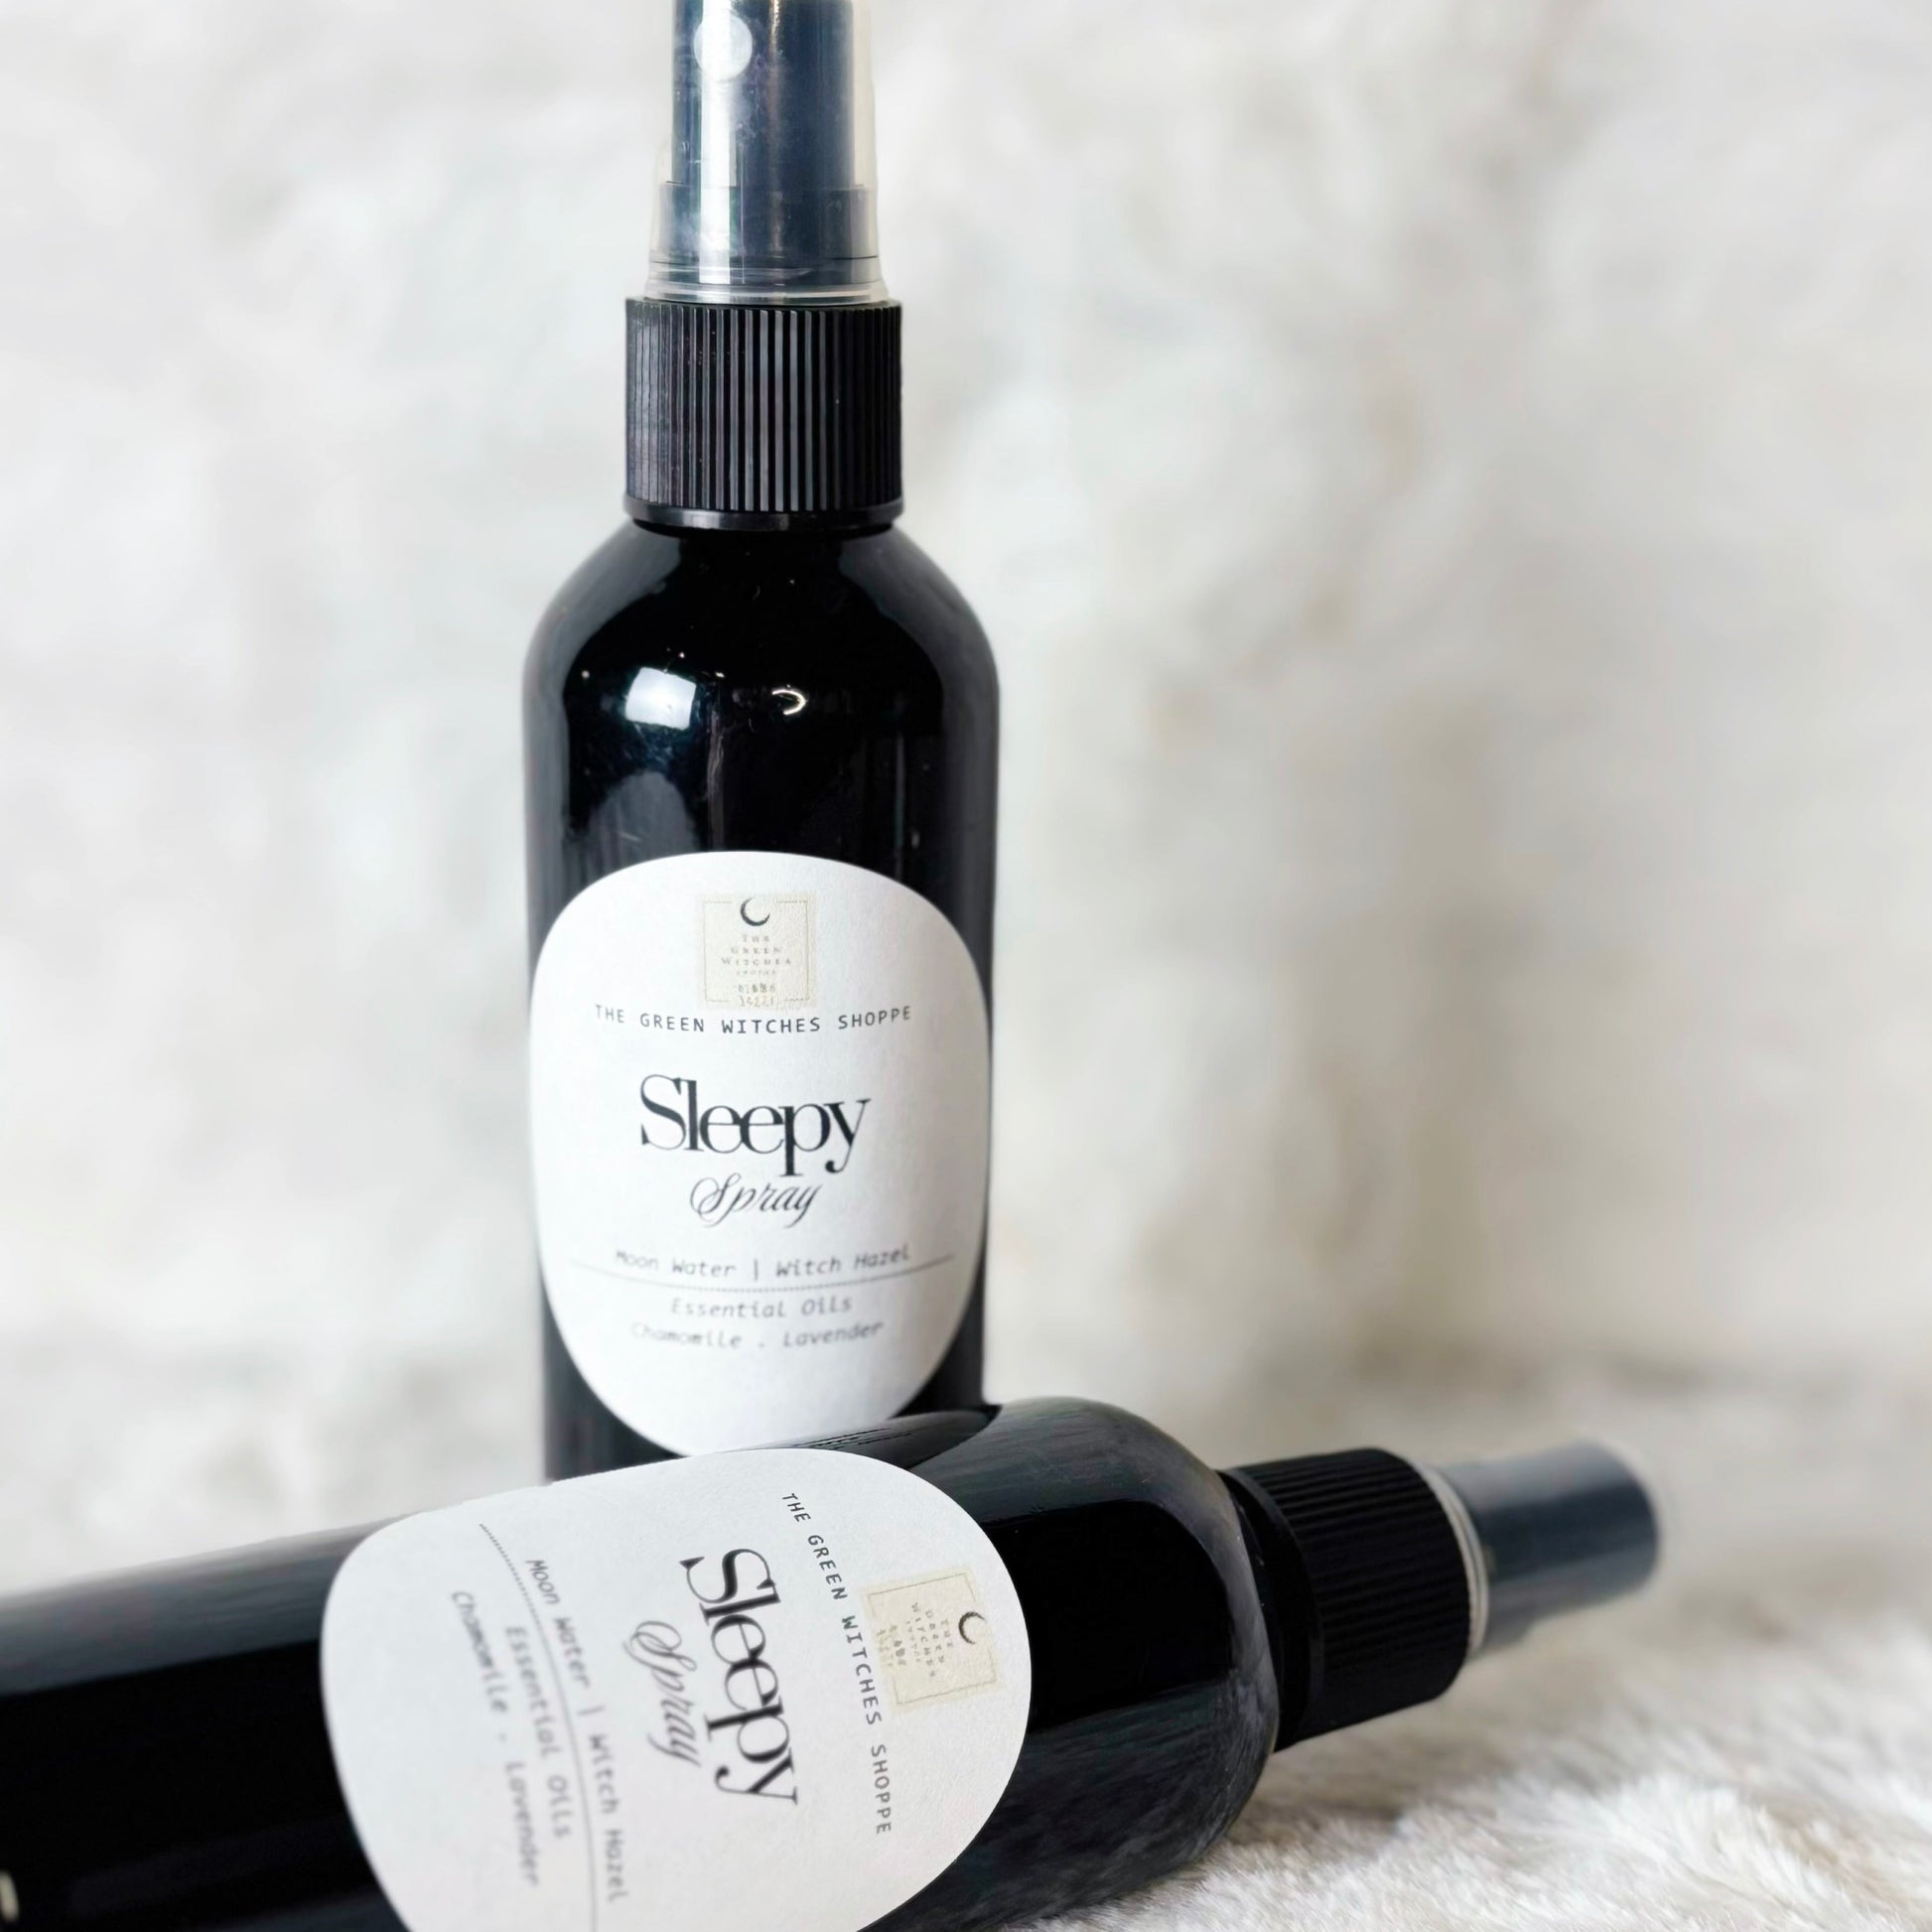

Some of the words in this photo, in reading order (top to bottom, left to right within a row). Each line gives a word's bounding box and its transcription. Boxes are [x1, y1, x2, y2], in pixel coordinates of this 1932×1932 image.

[596, 1005, 624, 1024] THE
[640, 1013, 704, 1033] GREEN
[722, 1018, 820, 1034] WITCHES
[838, 1005, 911, 1030] SHOPPE
[639, 1074, 871, 1177] Sleepy
[616, 1249, 658, 1272] Moon
[672, 1255, 736, 1279] Water
[776, 1259, 842, 1279] Witch
[854, 1244, 910, 1270] Hazel
[690, 1173, 823, 1228] Spray
[632, 1321, 743, 1348] Chamomile
[782, 1320, 885, 1347] Lavender
[671, 1297, 786, 1318] Essential
[801, 1297, 853, 1314] Oils
[623, 1620, 701, 1768] Spray
[679, 1548, 798, 1805] Sleepy
[782, 1493, 810, 1523] THE
[808, 1535, 847, 1600] GREEN
[842, 1616, 882, 1725] WITCHES
[872, 1744, 892, 1835] SHOPPE
[452, 1590, 507, 1714] Chamomile
[504, 1763, 539, 1885] Lavender
[505, 1626, 554, 1759] Essential
[547, 1777, 572, 1839] Oils
[525, 1559, 561, 1605] Moon
[554, 1616, 590, 1690] Water
[588, 1734, 618, 1815] Witch
[605, 1830, 629, 1902] Hazel
